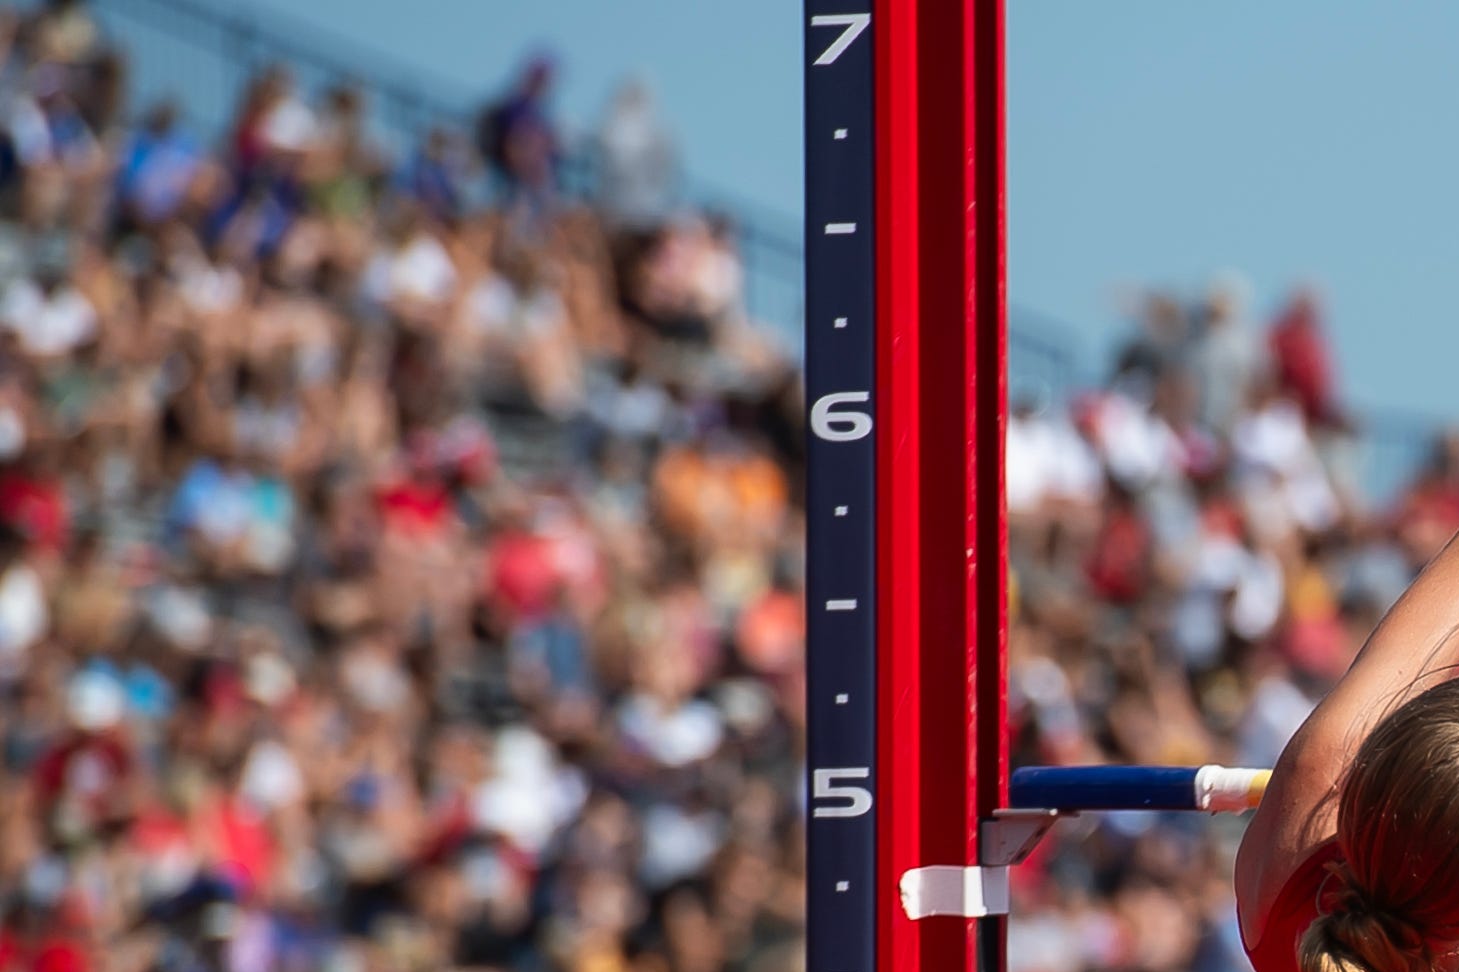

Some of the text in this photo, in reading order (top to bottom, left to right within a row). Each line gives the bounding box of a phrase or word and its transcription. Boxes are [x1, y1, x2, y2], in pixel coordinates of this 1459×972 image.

[811, 13, 871, 65] 7
[811, 391, 873, 442] 6
[813, 767, 873, 817] 5
